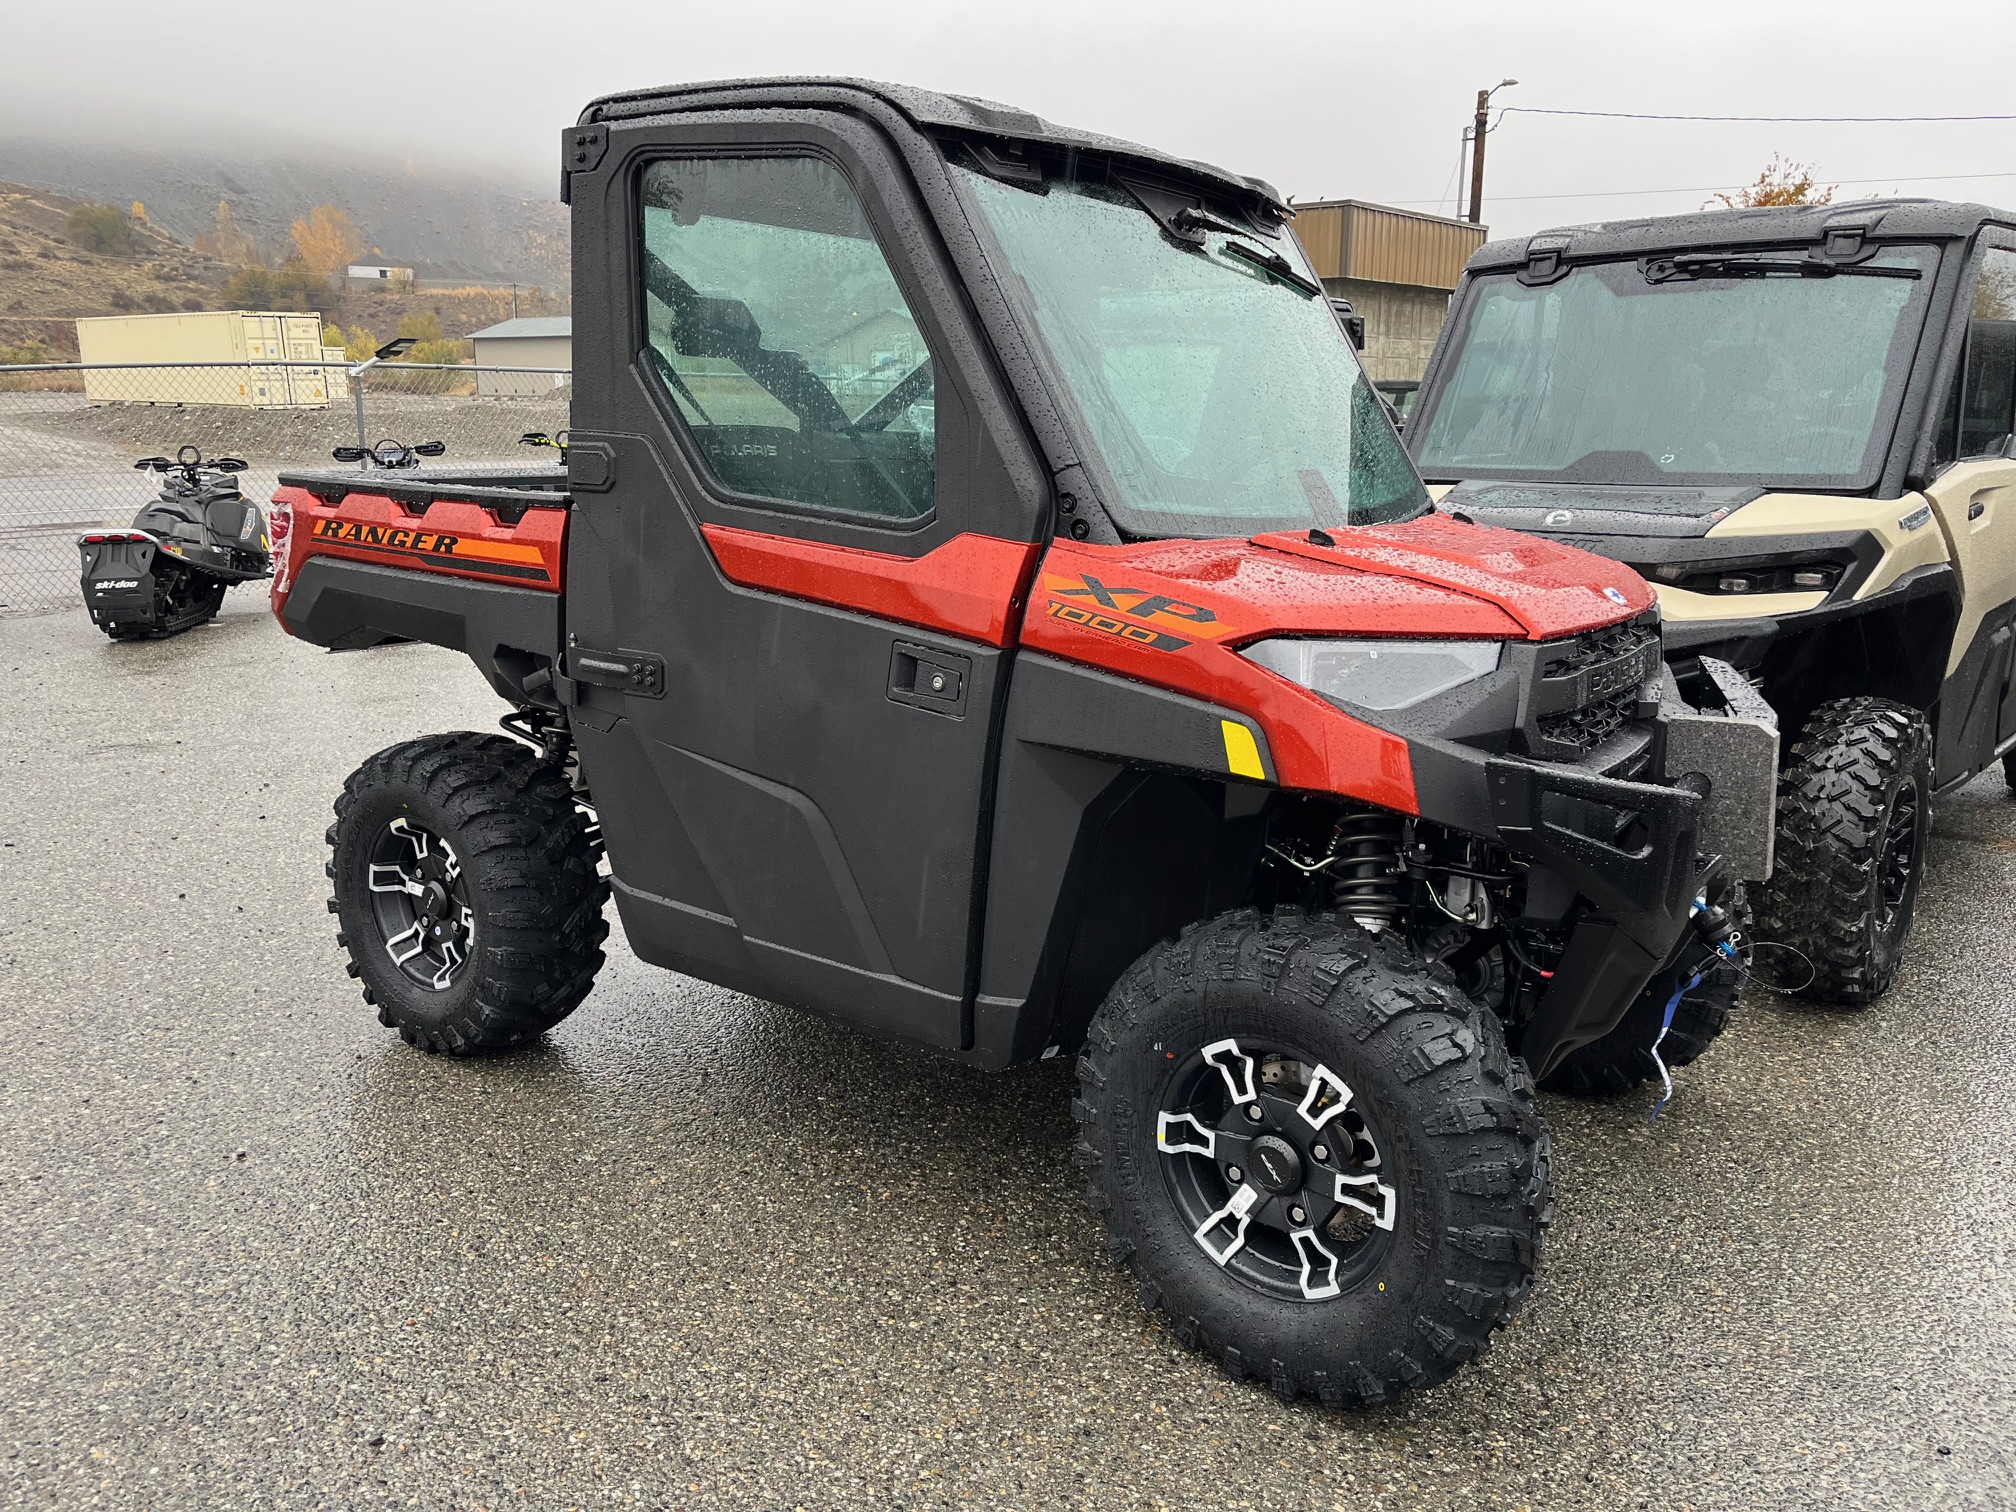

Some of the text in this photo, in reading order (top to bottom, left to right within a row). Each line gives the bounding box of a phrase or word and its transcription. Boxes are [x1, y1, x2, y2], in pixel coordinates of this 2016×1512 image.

[320, 519, 459, 554] RANGER
[94, 579, 139, 590] ski-doo
[1050, 573, 1218, 624] XP
[1044, 618, 1151, 653] DUAL OVERHEAD CAM
[1046, 602, 1159, 644] 1000
